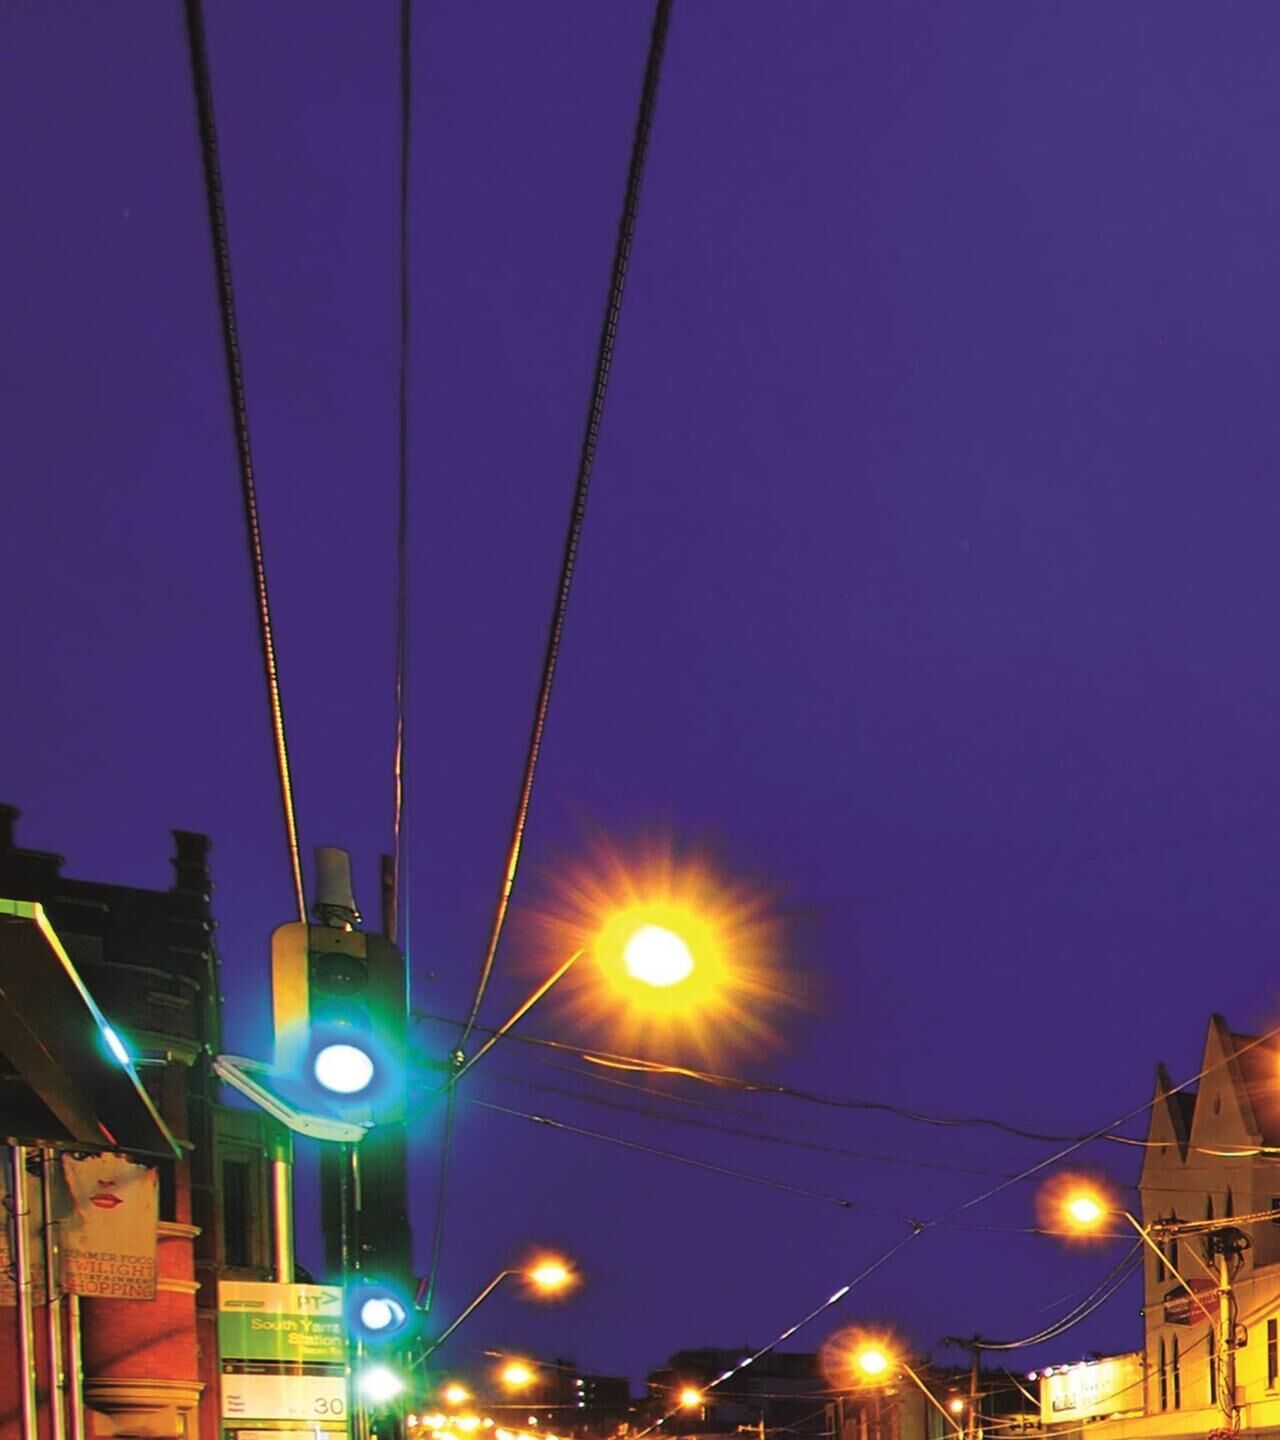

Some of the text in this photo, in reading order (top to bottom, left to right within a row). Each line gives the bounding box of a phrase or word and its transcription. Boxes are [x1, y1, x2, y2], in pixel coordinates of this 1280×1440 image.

[65, 1259, 154, 1277] TWILIGHT
[62, 1278, 154, 1298] SHOPPING
[314, 1397, 344, 1415] 30
